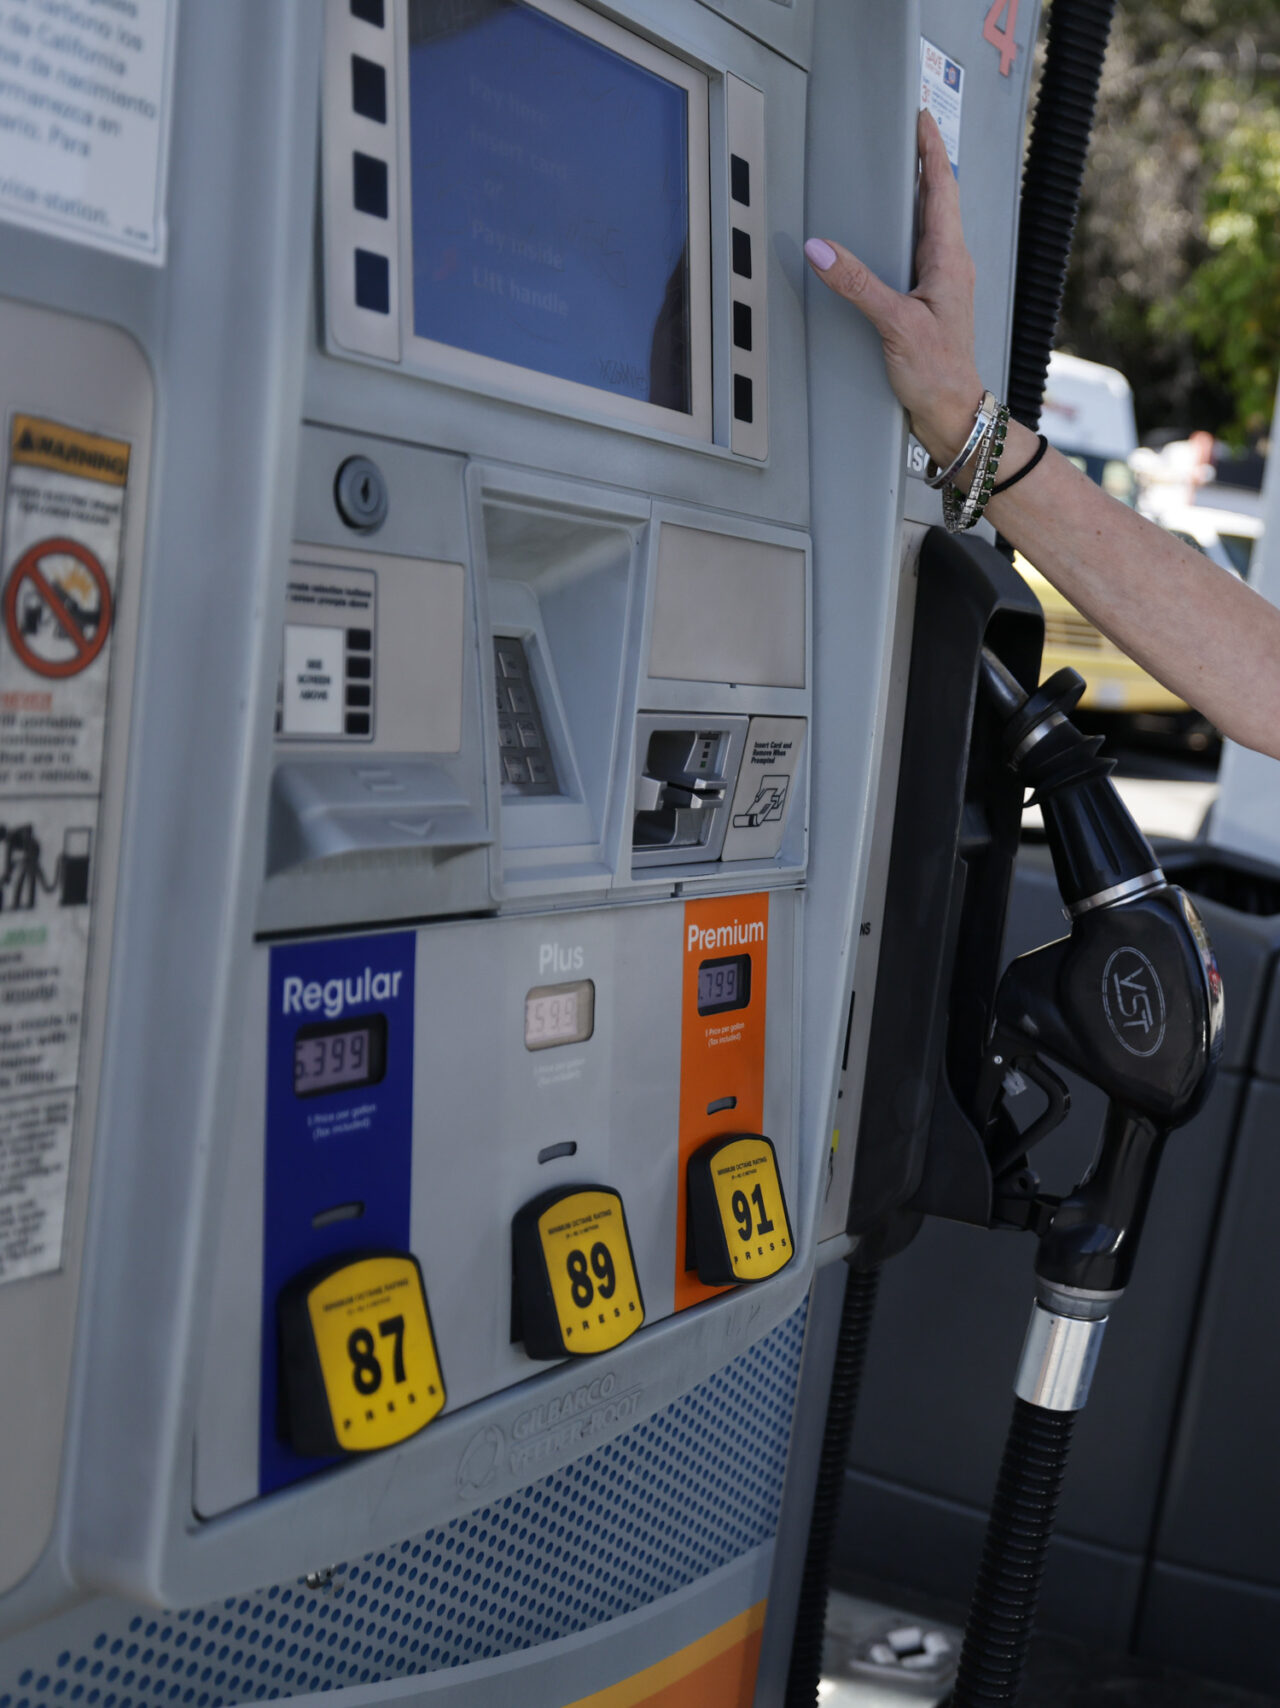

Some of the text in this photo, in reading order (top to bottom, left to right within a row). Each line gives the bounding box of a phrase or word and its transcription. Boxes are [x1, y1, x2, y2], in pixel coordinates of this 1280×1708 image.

[982, 0, 1019, 77] 4
[539, 943, 584, 975] Plus
[687, 918, 764, 952] Premium
[282, 966, 402, 1018] Regular
[1113, 966, 1154, 1035] VST
[731, 1183, 774, 1242] 91
[567, 1241, 616, 1308] 89
[734, 1238, 787, 1265] PRESS
[566, 1301, 636, 1338] PRESS
[347, 1313, 407, 1396] 87
[512, 1371, 616, 1441] GILBARCO
